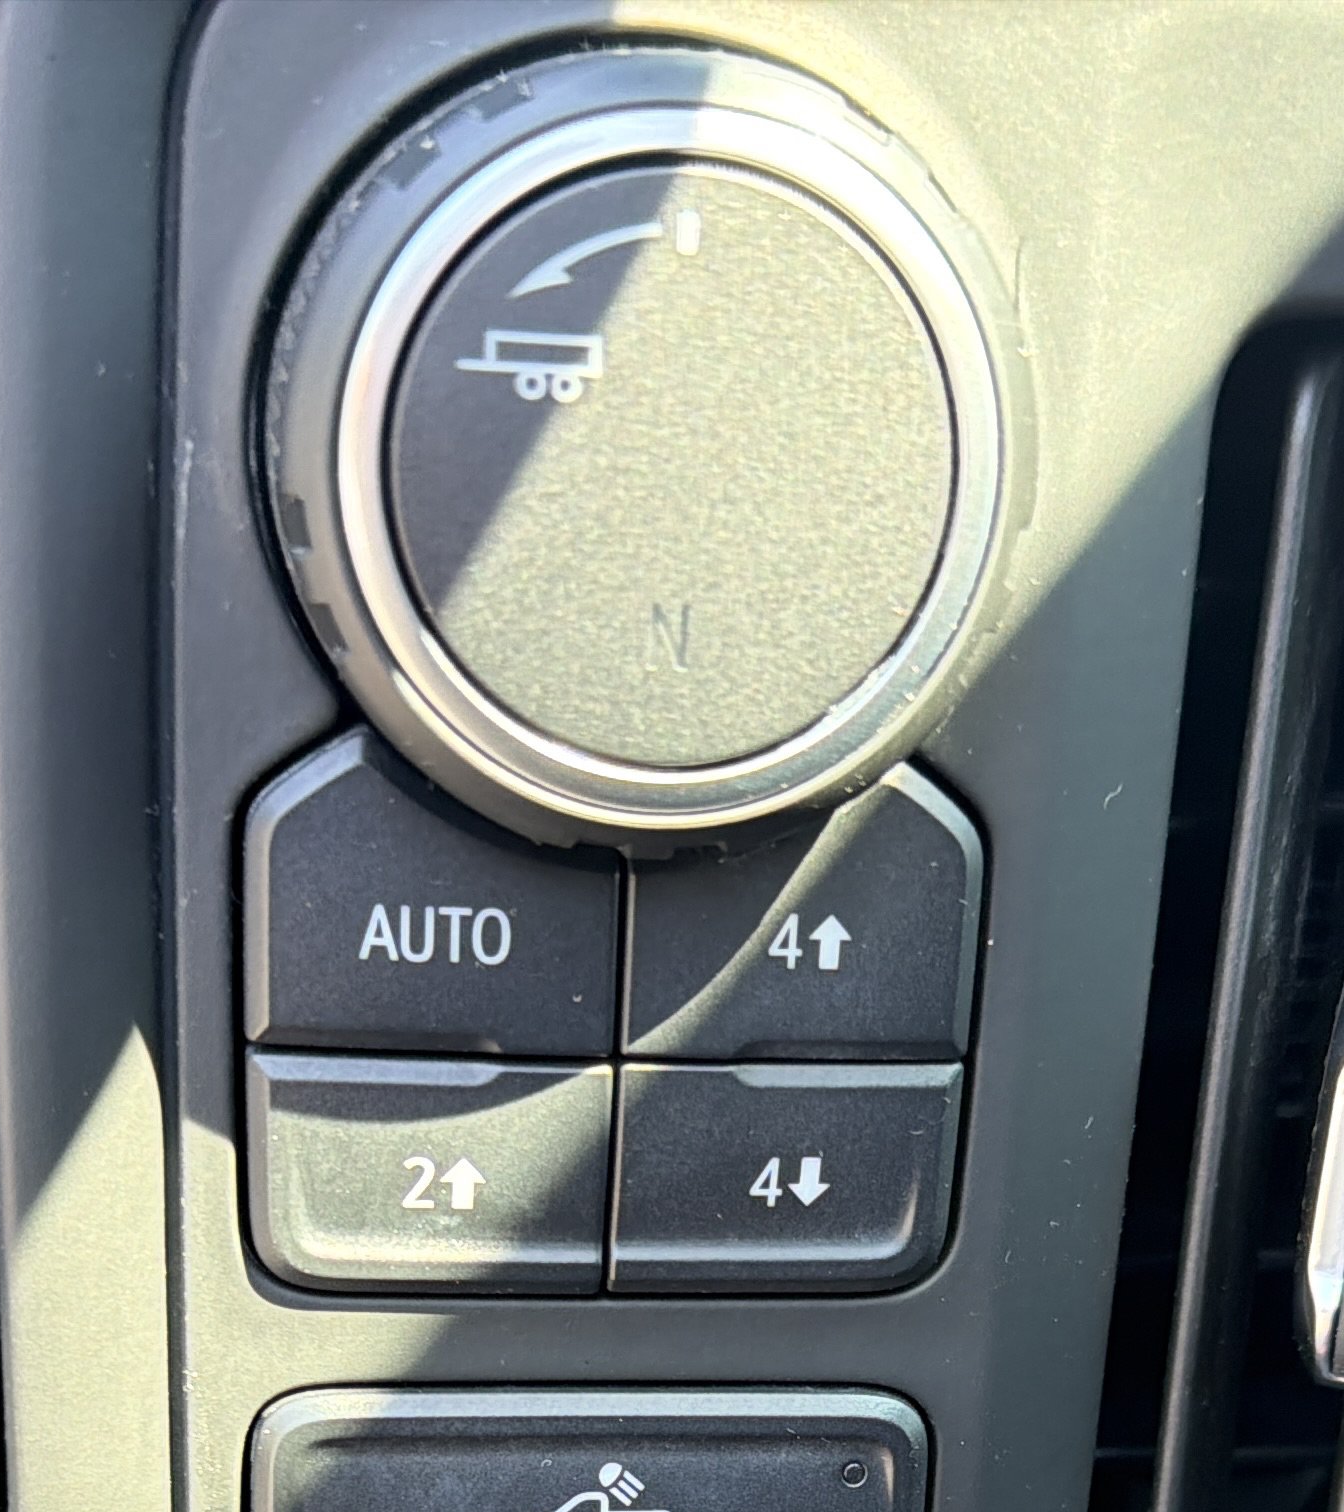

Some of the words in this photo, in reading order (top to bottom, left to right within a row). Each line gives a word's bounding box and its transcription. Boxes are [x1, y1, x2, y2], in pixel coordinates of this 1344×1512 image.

[644, 602, 692, 672] N
[358, 904, 512, 966] AUTO
[767, 913, 803, 970] 4
[401, 1156, 437, 1211] 2
[748, 1157, 783, 1208] 4
